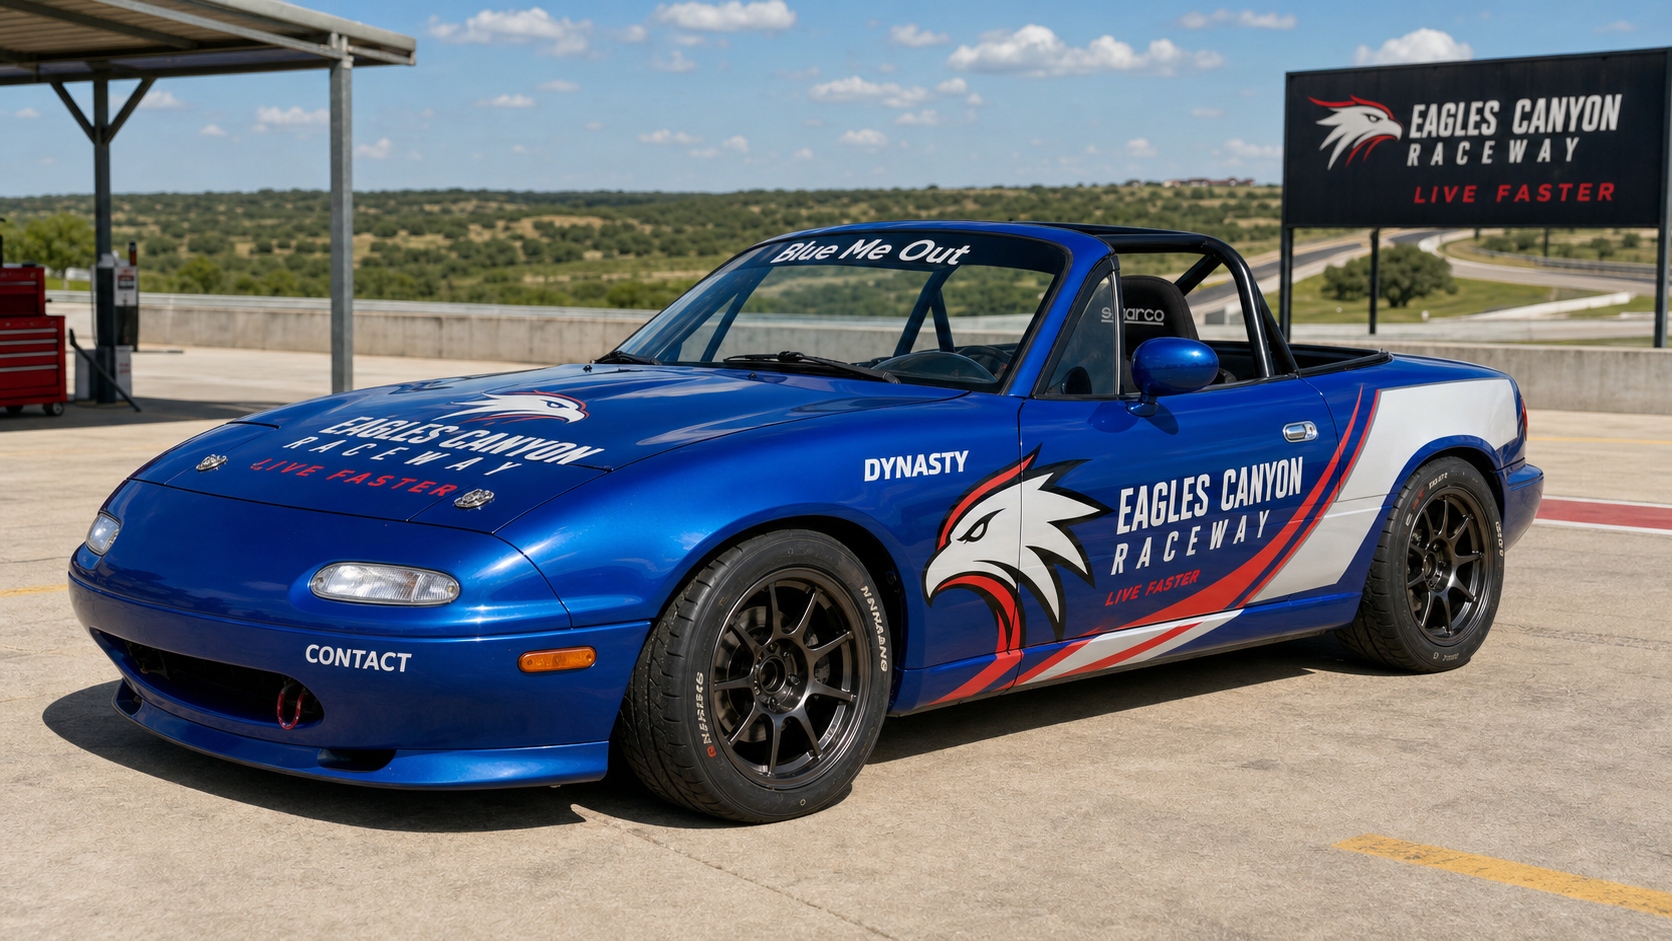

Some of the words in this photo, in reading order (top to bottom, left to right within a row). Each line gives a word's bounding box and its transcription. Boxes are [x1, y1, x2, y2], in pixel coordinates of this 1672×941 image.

[1409, 100, 1500, 139] EAGLES
[1512, 93, 1623, 135] CANYON
[1406, 137, 1580, 167] RACEWAY
[1413, 185, 1478, 204] LIVE
[1496, 182, 1616, 203] FASTER
[770, 240, 839, 264] Blue
[838, 238, 893, 260] Me
[898, 239, 972, 266] Out
[282, 436, 522, 477] RACEWAY
[318, 416, 460, 444] EAGLES
[438, 429, 605, 465] CANYON
[250, 458, 325, 477] LIVE
[326, 469, 459, 497] FASTER
[863, 450, 970, 483] DYNASTY
[1116, 473, 1210, 535] EAGLES
[1220, 456, 1304, 512] CANYON
[1110, 509, 1270, 576] RACEWAY
[1105, 584, 1142, 607] LIVE
[1145, 569, 1201, 596] FASTER
[305, 643, 413, 673] CONTACT
